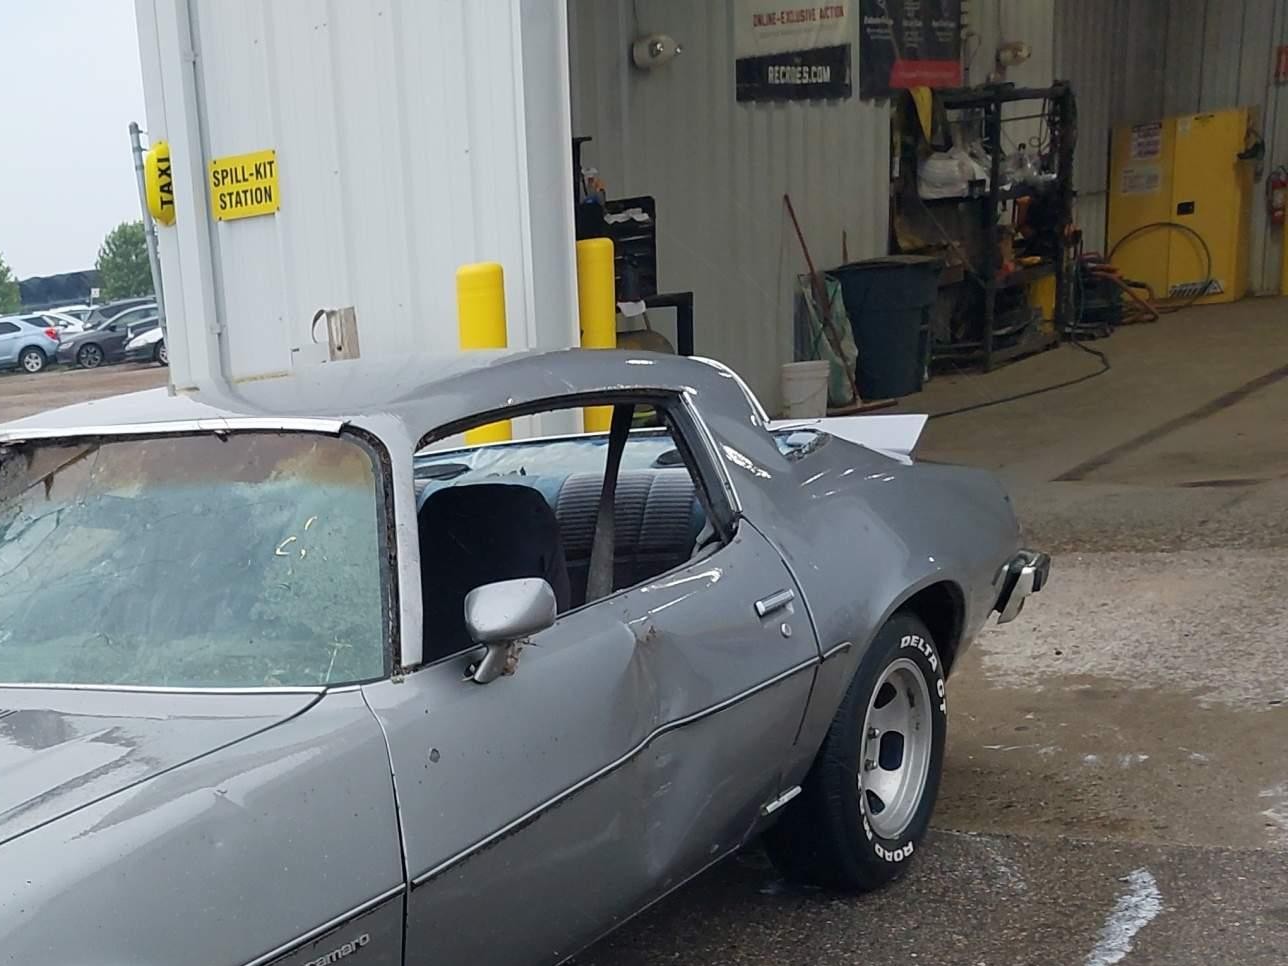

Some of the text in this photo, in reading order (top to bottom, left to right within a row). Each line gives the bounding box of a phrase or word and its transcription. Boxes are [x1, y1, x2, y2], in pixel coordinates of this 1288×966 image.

[157, 157, 174, 210] TAXI
[212, 160, 275, 188] SPILL-KIT
[219, 185, 272, 210] STATION
[900, 635, 938, 673] DELTA
[875, 841, 914, 862] ROAD
